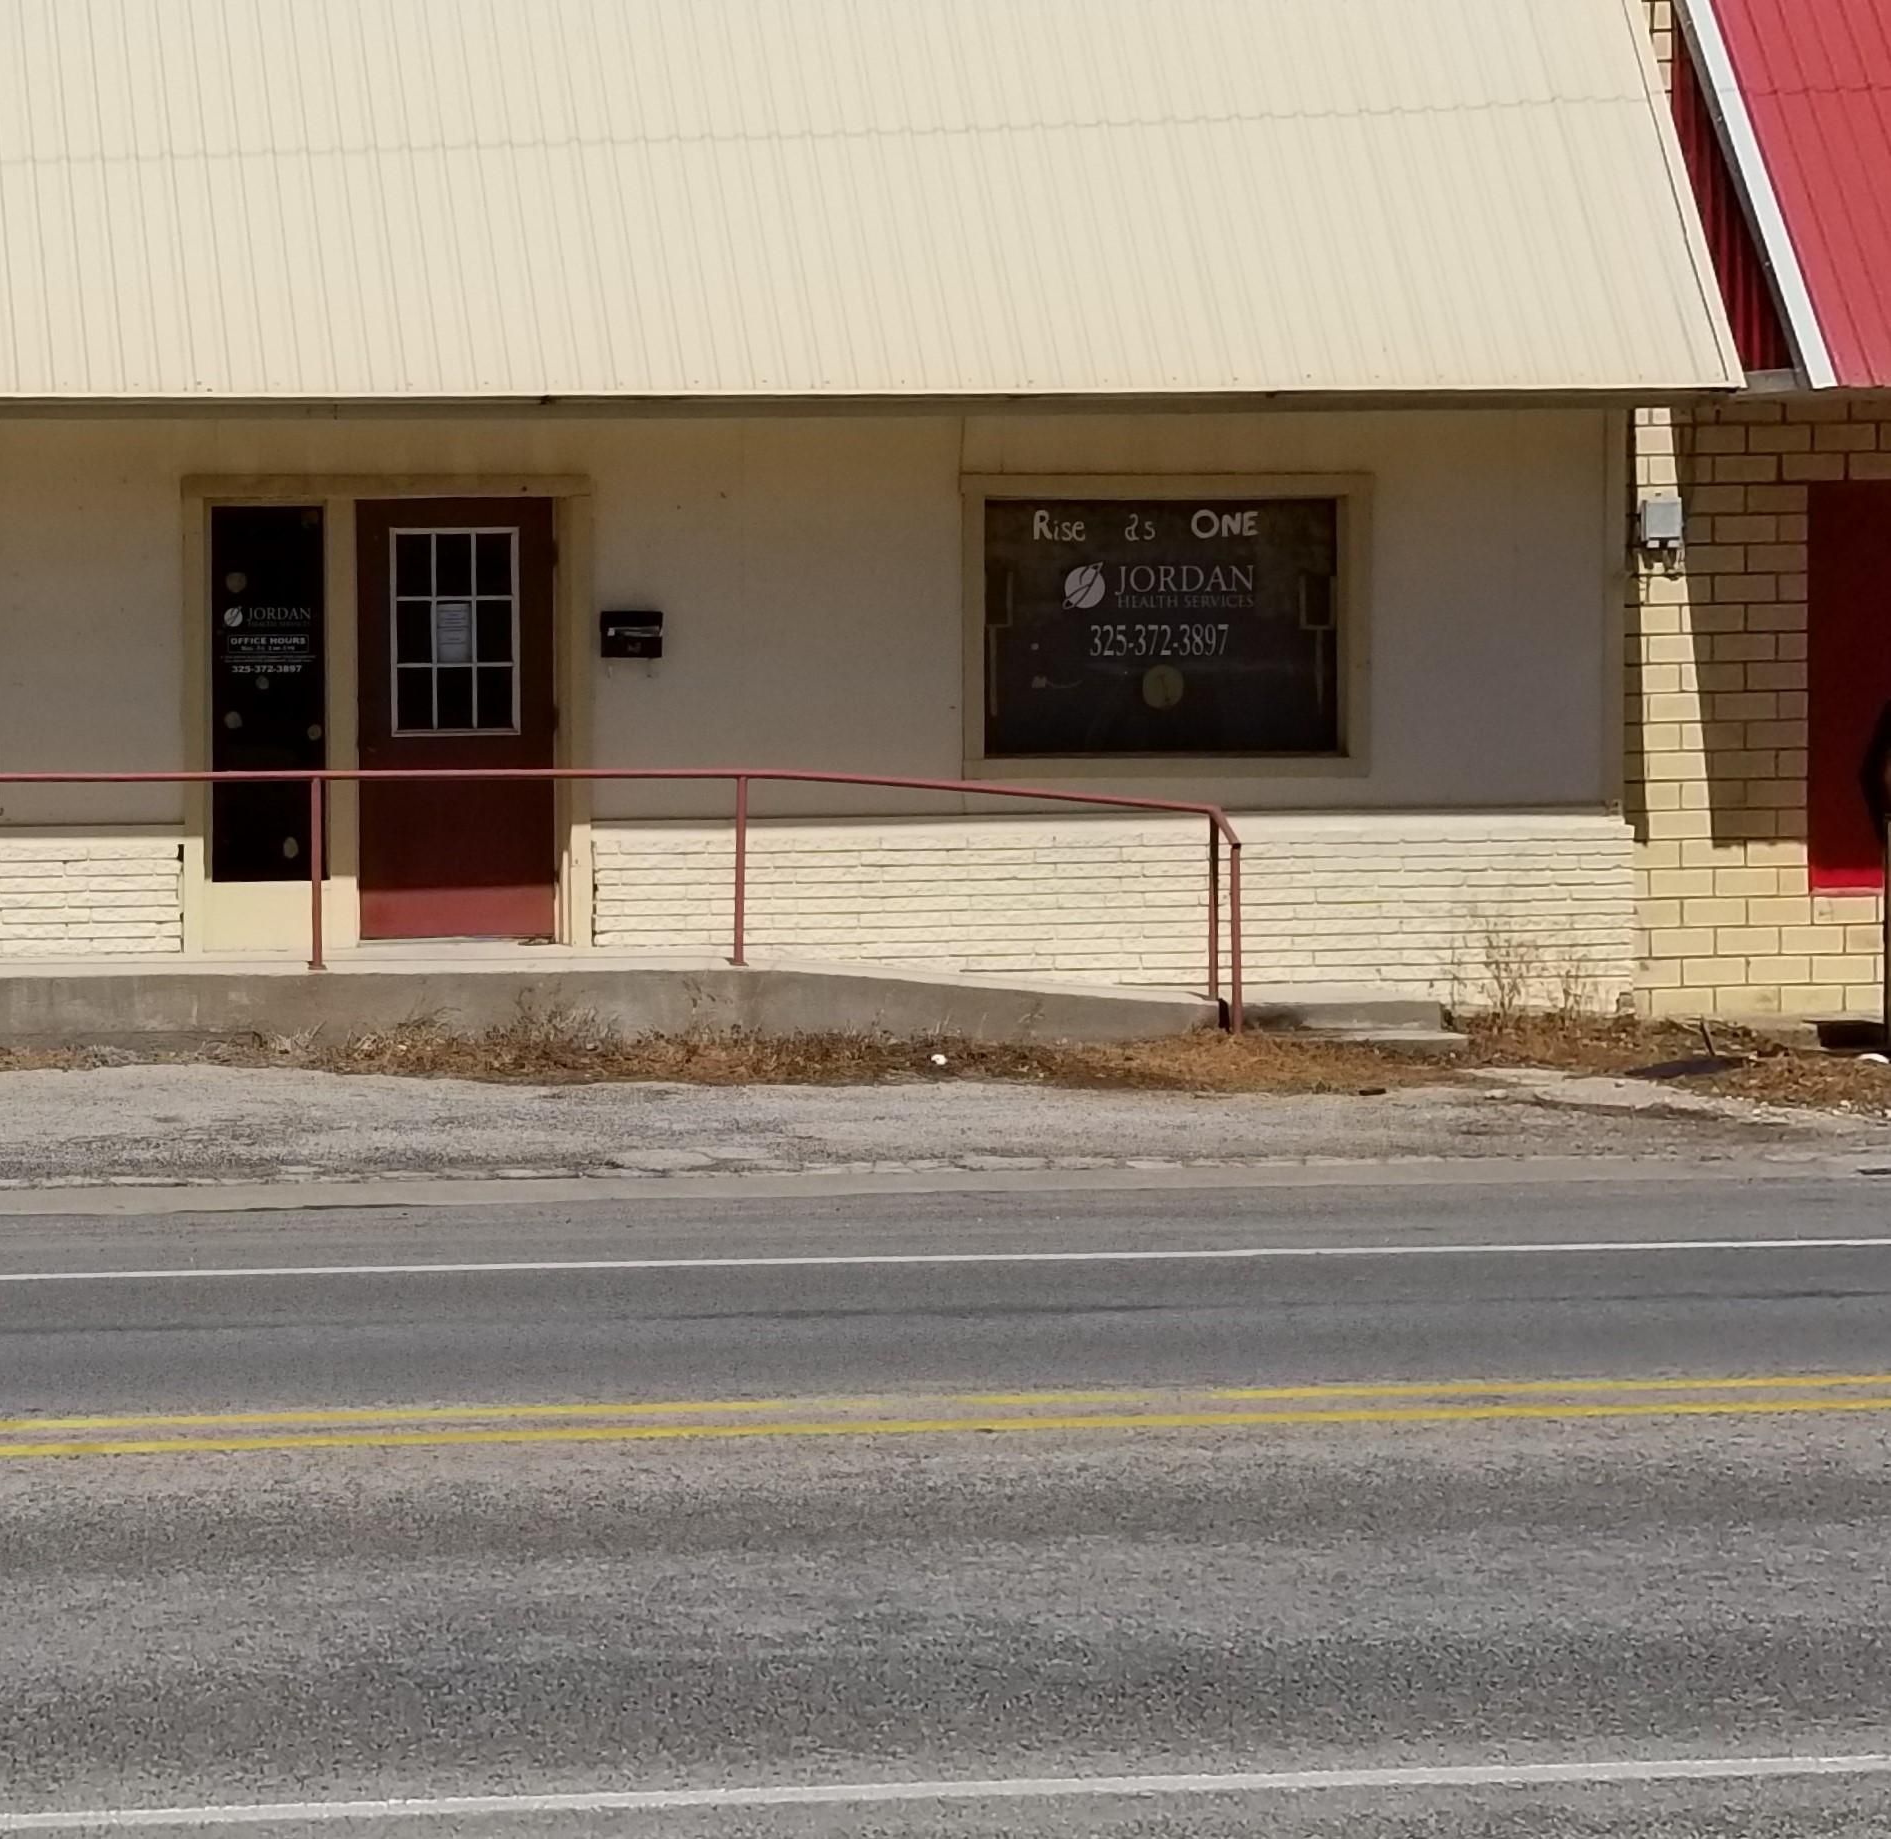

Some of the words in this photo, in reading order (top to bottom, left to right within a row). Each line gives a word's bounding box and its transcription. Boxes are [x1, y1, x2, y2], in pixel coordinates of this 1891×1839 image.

[1033, 509, 1086, 541] Rise
[1191, 509, 1259, 539] ONE
[1115, 565, 1254, 595] JORDAN
[1117, 595, 1179, 609] HEALTH
[1184, 595, 1254, 609] SERVICES
[247, 607, 311, 621] JORDAN
[230, 637, 267, 645] OFFICE
[270, 637, 306, 645] HOURS
[1089, 624, 1229, 656] 325-372-3897
[232, 665, 302, 673] 325-372-3897
